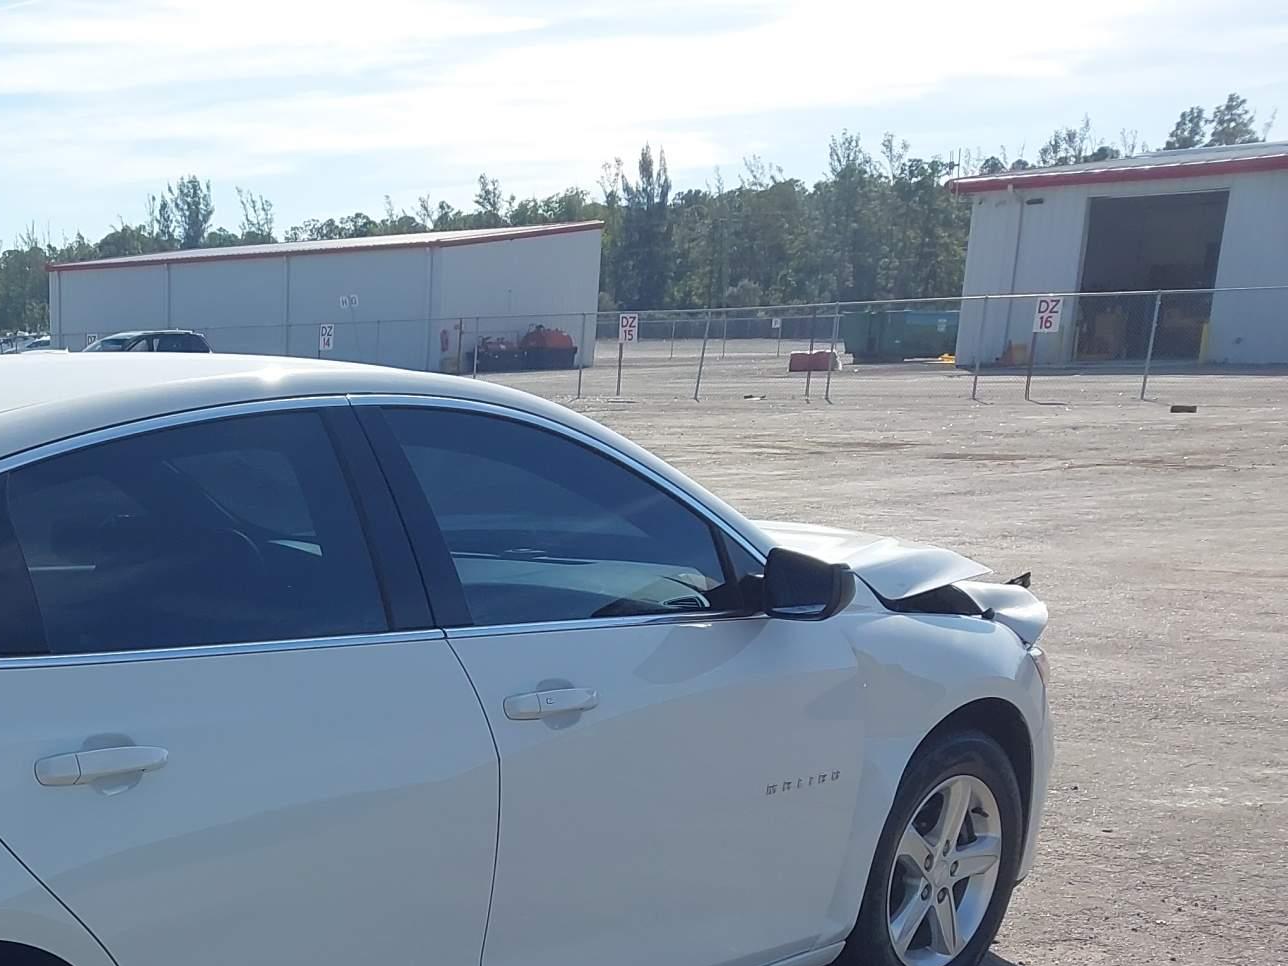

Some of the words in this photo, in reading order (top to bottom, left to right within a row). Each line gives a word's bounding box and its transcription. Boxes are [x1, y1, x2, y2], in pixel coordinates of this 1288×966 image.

[1038, 299, 1060, 313] DZ
[621, 316, 636, 328] DZ
[1039, 315, 1052, 329] 16
[321, 326, 332, 337] DZ
[624, 329, 633, 341] 15
